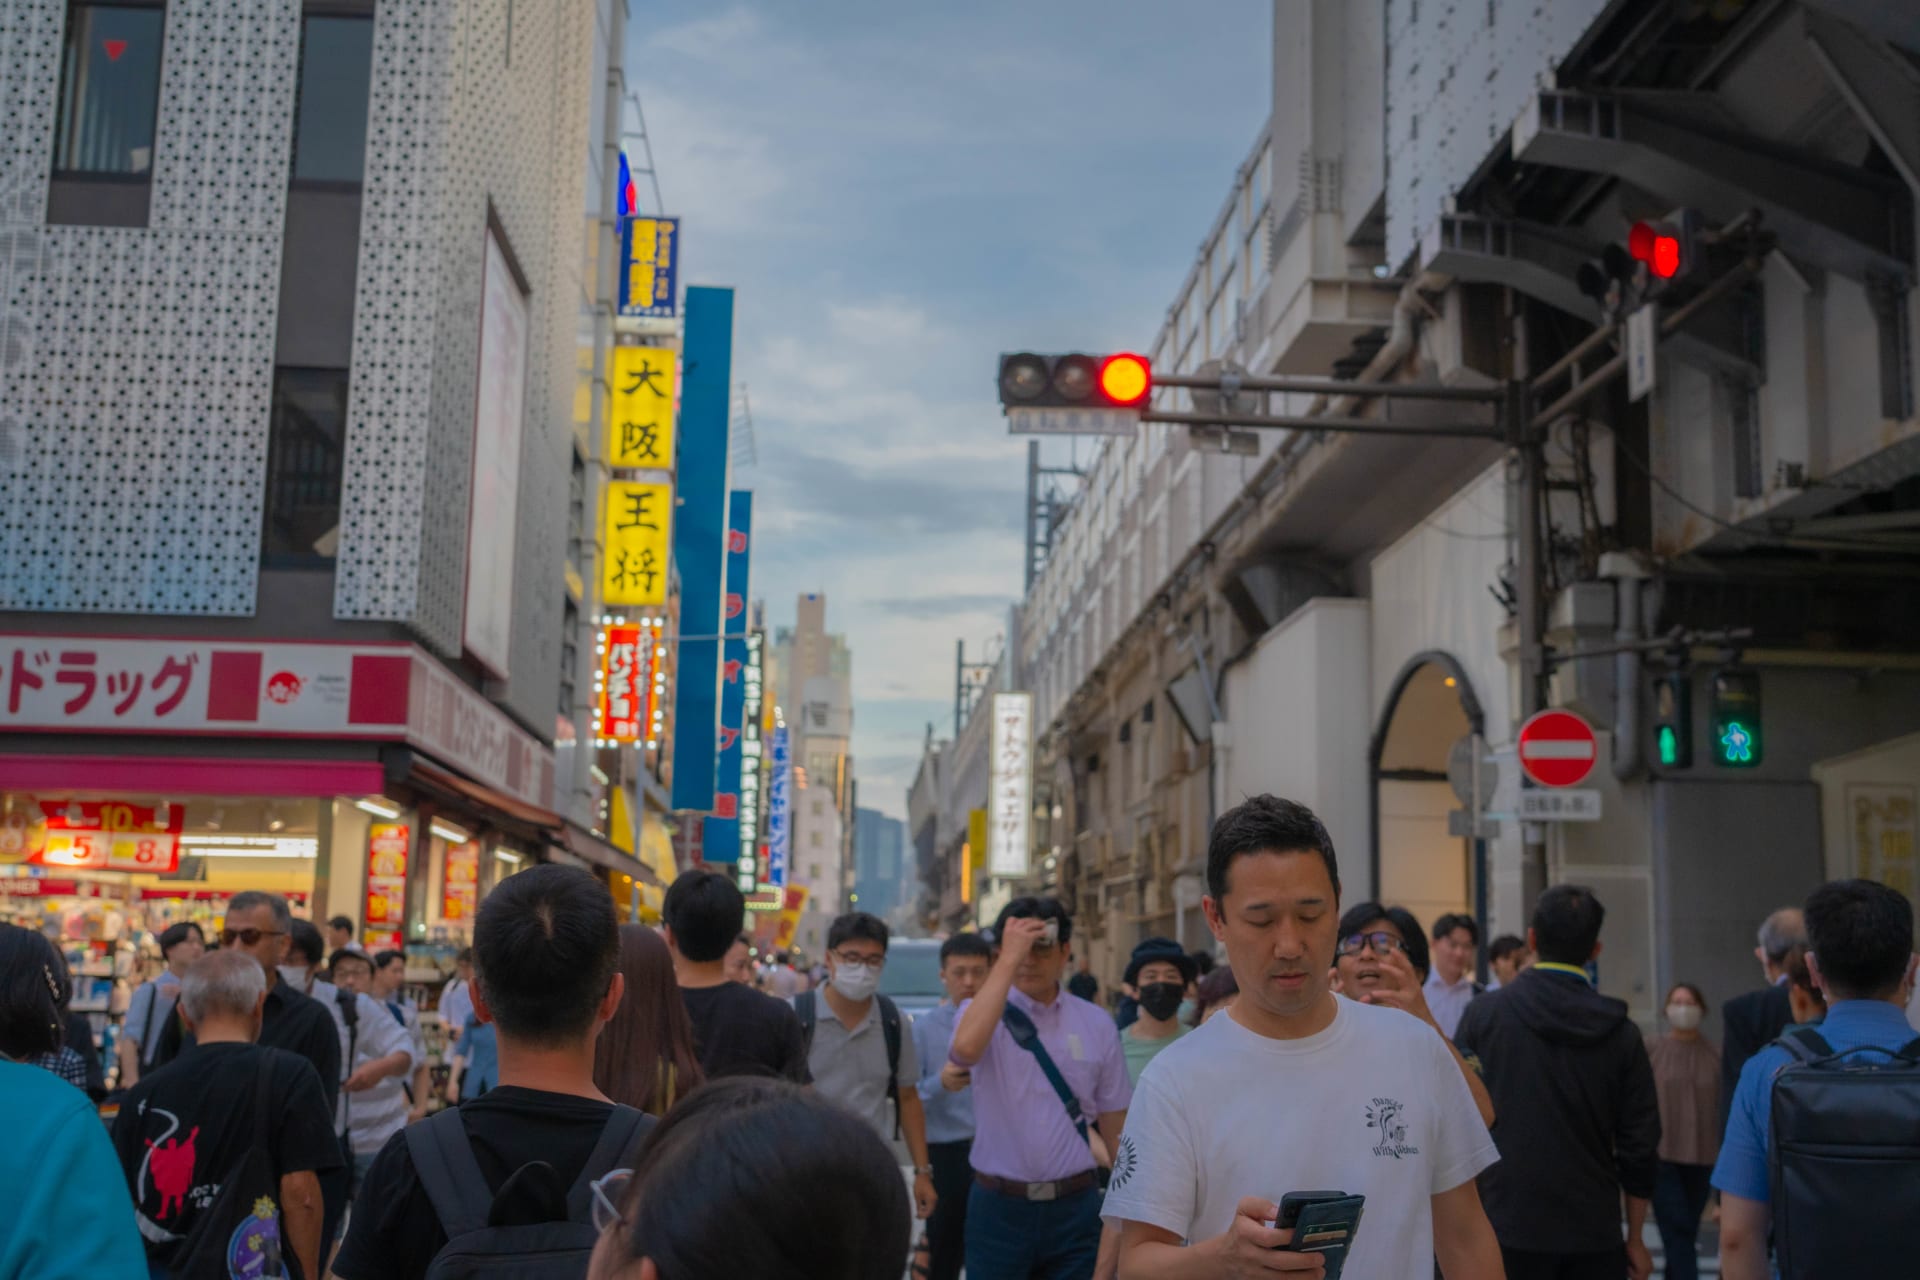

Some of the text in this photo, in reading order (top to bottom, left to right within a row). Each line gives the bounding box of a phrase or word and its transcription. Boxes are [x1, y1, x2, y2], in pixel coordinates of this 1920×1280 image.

[620, 359, 668, 459] 大阪
[611, 490, 659, 593] 王将
[0, 648, 198, 716] ドラッグ
[737, 723, 762, 892] IMPRESSION
